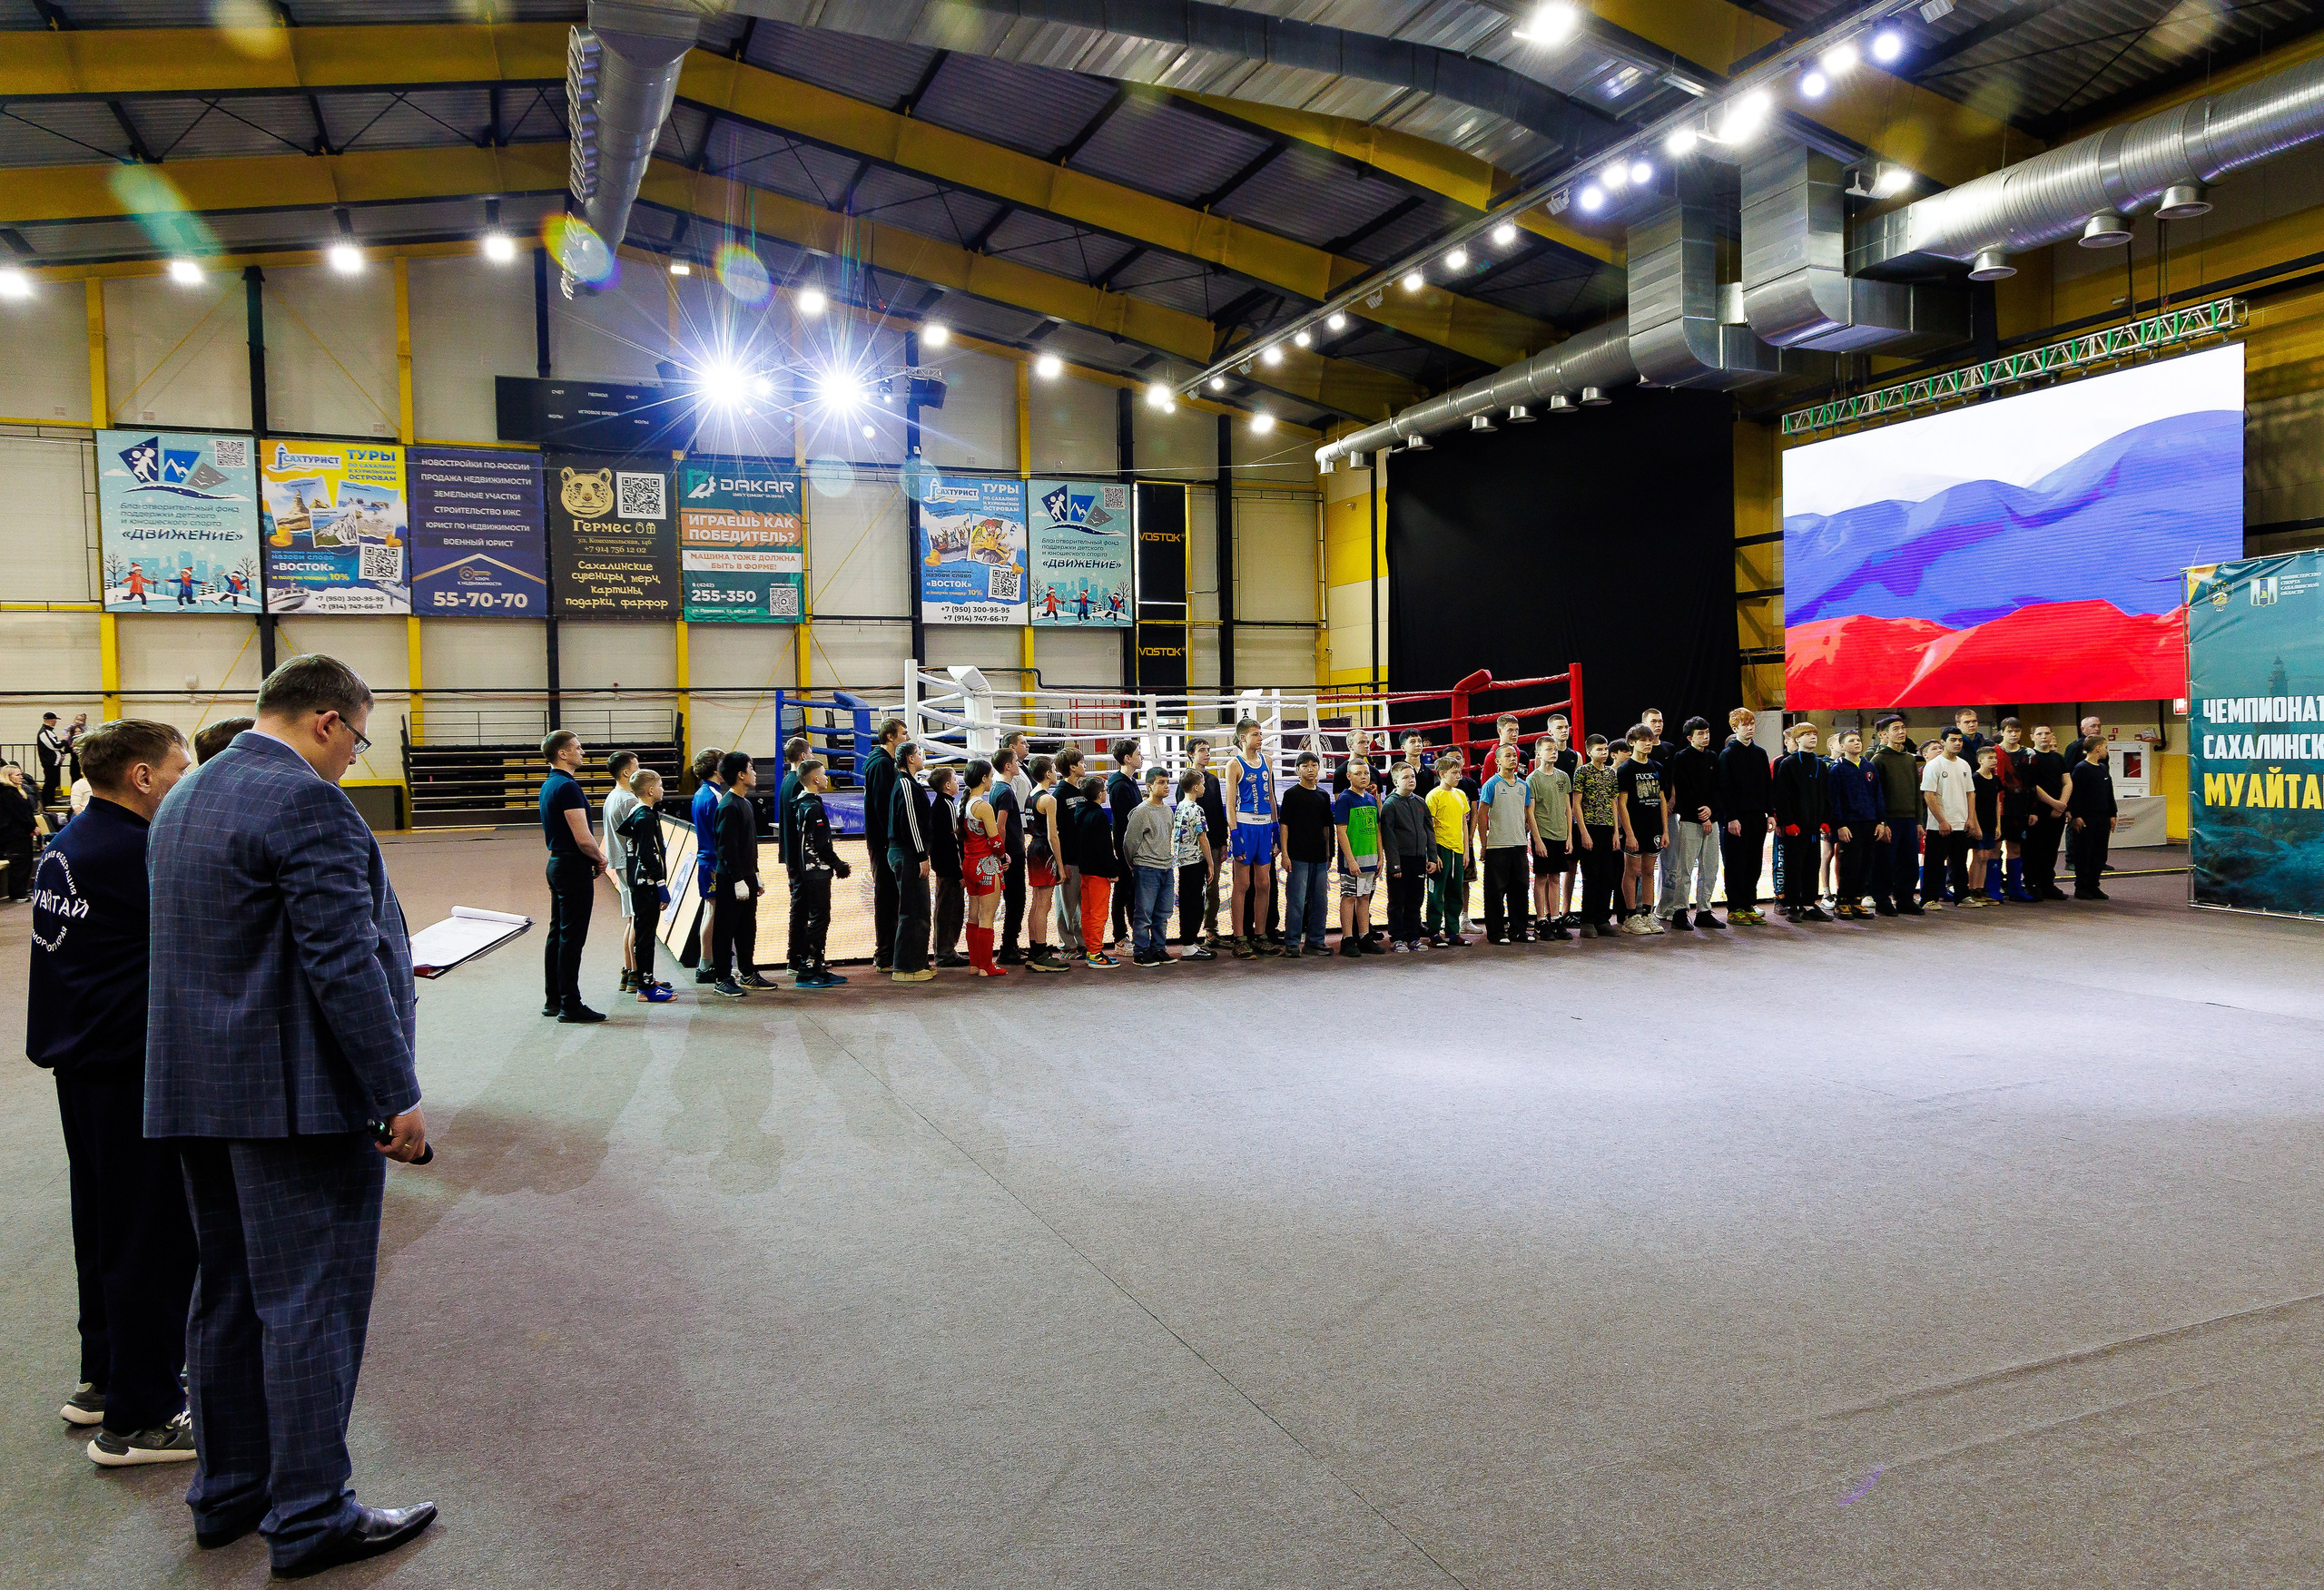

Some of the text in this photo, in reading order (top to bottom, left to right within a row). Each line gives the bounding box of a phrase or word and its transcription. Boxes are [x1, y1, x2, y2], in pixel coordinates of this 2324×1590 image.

[283, 455, 340, 466] САХТУРИСТ
[346, 449, 396, 461] ТУРЫ
[422, 459, 482, 468] НОВОСТРОЙКИ
[497, 463, 530, 471] РОССИИ
[421, 474, 532, 486] ПРОДАЖА НЕДВИЖИМОСТИ
[721, 479, 795, 494] DAKAR
[936, 488, 978, 496] САХТУРИСТ
[982, 483, 1019, 494] ТУРЫ
[434, 490, 483, 499] ЗЕМЕЛЬНЫЕ
[121, 503, 240, 514] Благотворительный фонд
[434, 506, 501, 515] СТРОИТЕЛЬСТВО
[121, 511, 174, 519] поддержки
[130, 519, 188, 527] юношеского
[573, 520, 632, 533] Гермес
[689, 515, 794, 528] ИГРАЕШЬ КАК
[467, 524, 530, 532] НЕДВИЖИМОСТИ
[122, 528, 243, 542] «ДВИЖЕНИЕ»
[689, 529, 795, 543] ПОБЕДИТЕЛЬ?
[1139, 533, 1181, 543] VOSTOK
[1042, 538, 1102, 546] Благотворительный
[691, 553, 730, 561] МАШИНА
[272, 563, 335, 571] «ВОСТОК»
[578, 561, 653, 571] Сахалинские
[1042, 559, 1121, 569] «ДВИЖЕНИЕ»
[572, 573, 661, 584] сувениры, мерч,
[591, 585, 644, 596] картины,
[691, 589, 757, 603] 255-350
[433, 592, 528, 608] 55-70-70
[566, 598, 669, 610] подарки, фарфор
[1139, 647, 1181, 656] VOSTOK
[2203, 767, 2324, 810] МУАЙТА
[56, 851, 77, 896] ФЕДЕРАЦИЯ
